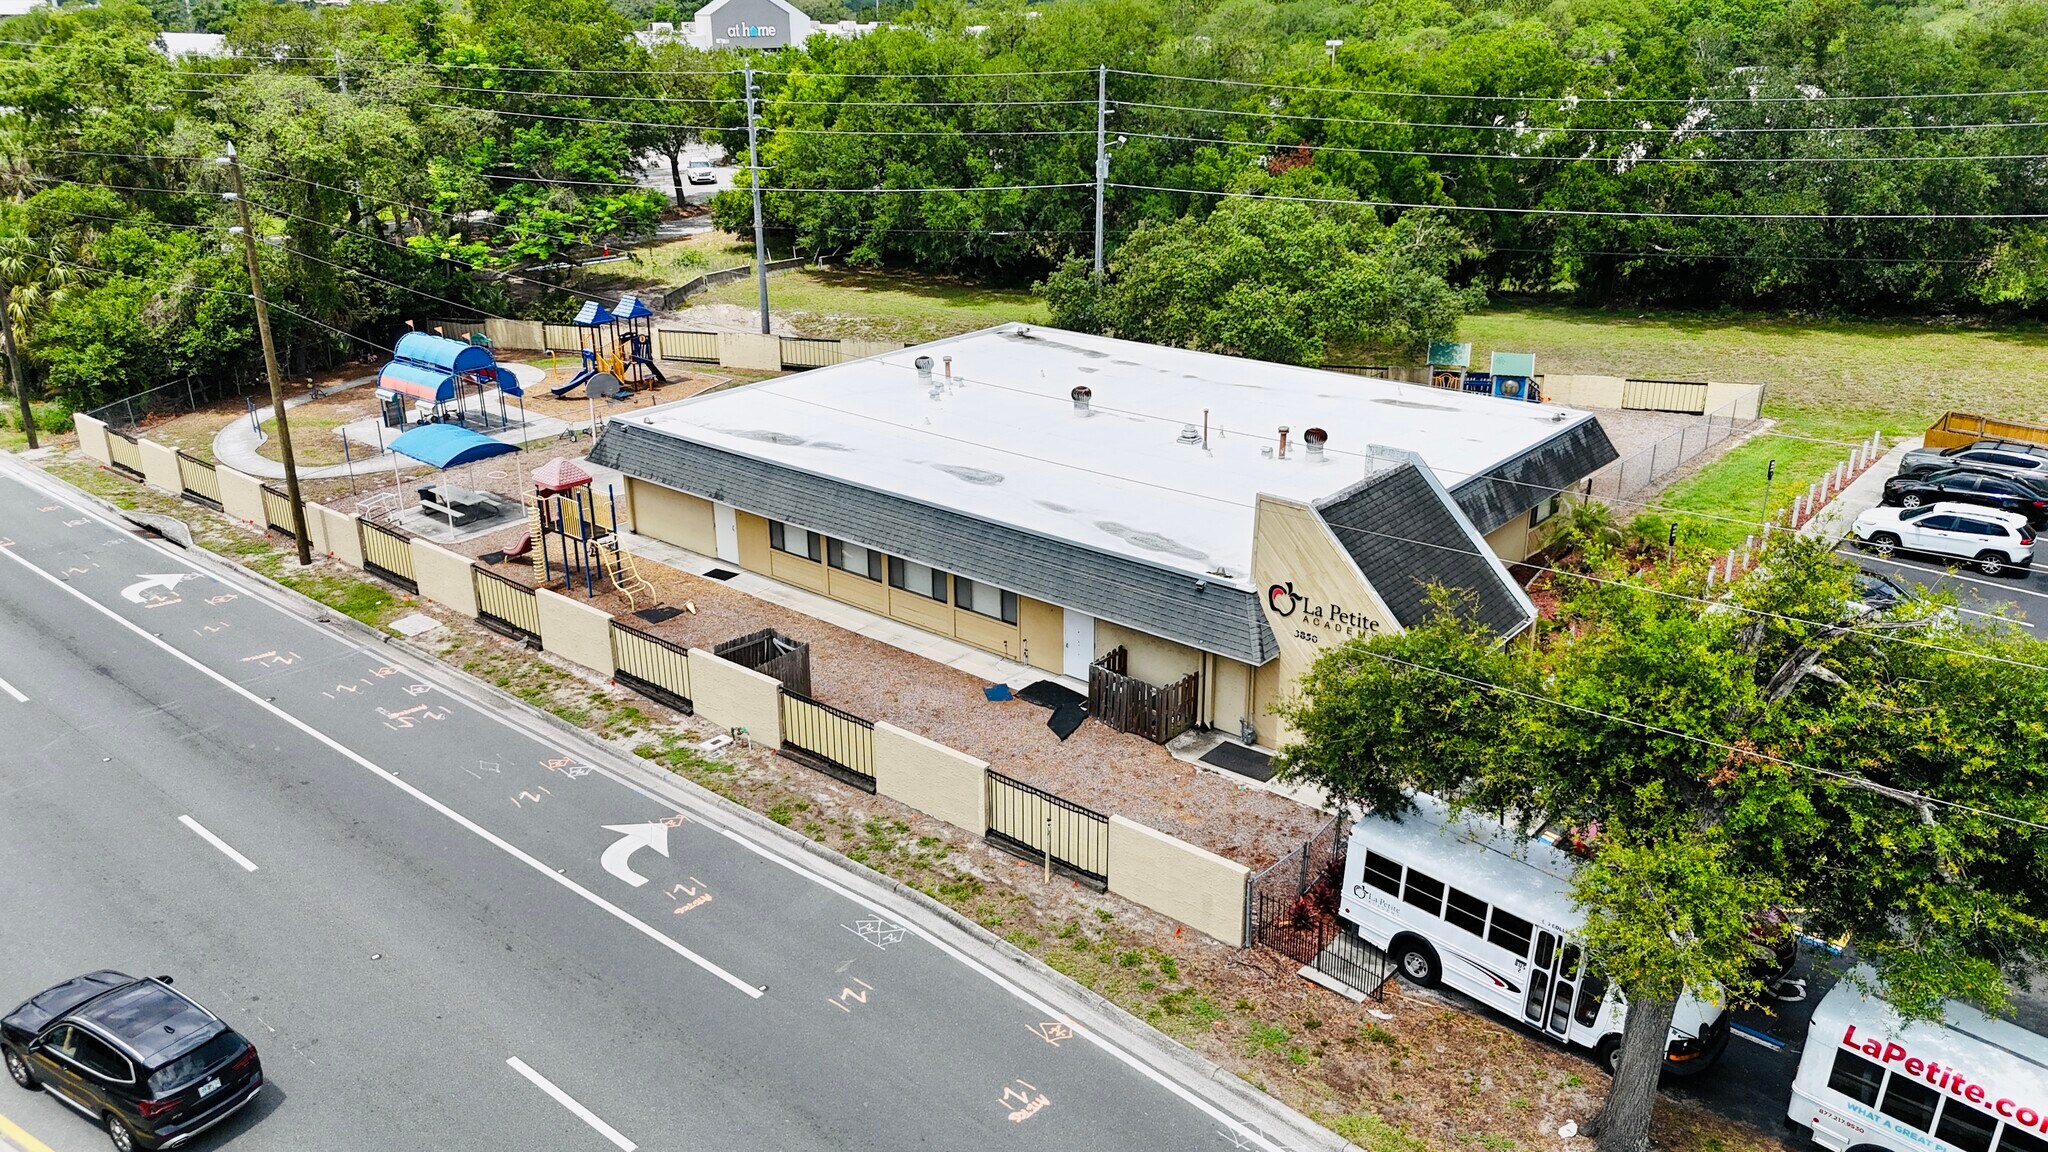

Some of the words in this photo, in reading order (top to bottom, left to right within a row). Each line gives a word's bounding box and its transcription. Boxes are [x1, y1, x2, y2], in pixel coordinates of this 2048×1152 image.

[727, 24, 740, 37] at
[741, 22, 776, 37] home
[1303, 597, 1323, 617] La
[1330, 604, 1380, 631] Petite
[1294, 630, 1318, 643] 3850
[1303, 615, 1375, 639] ACADEM
[1847, 1102, 1882, 1123] WHAT
[1883, 1119, 1892, 1129] A
[1894, 1125, 1933, 1147] GREAT
